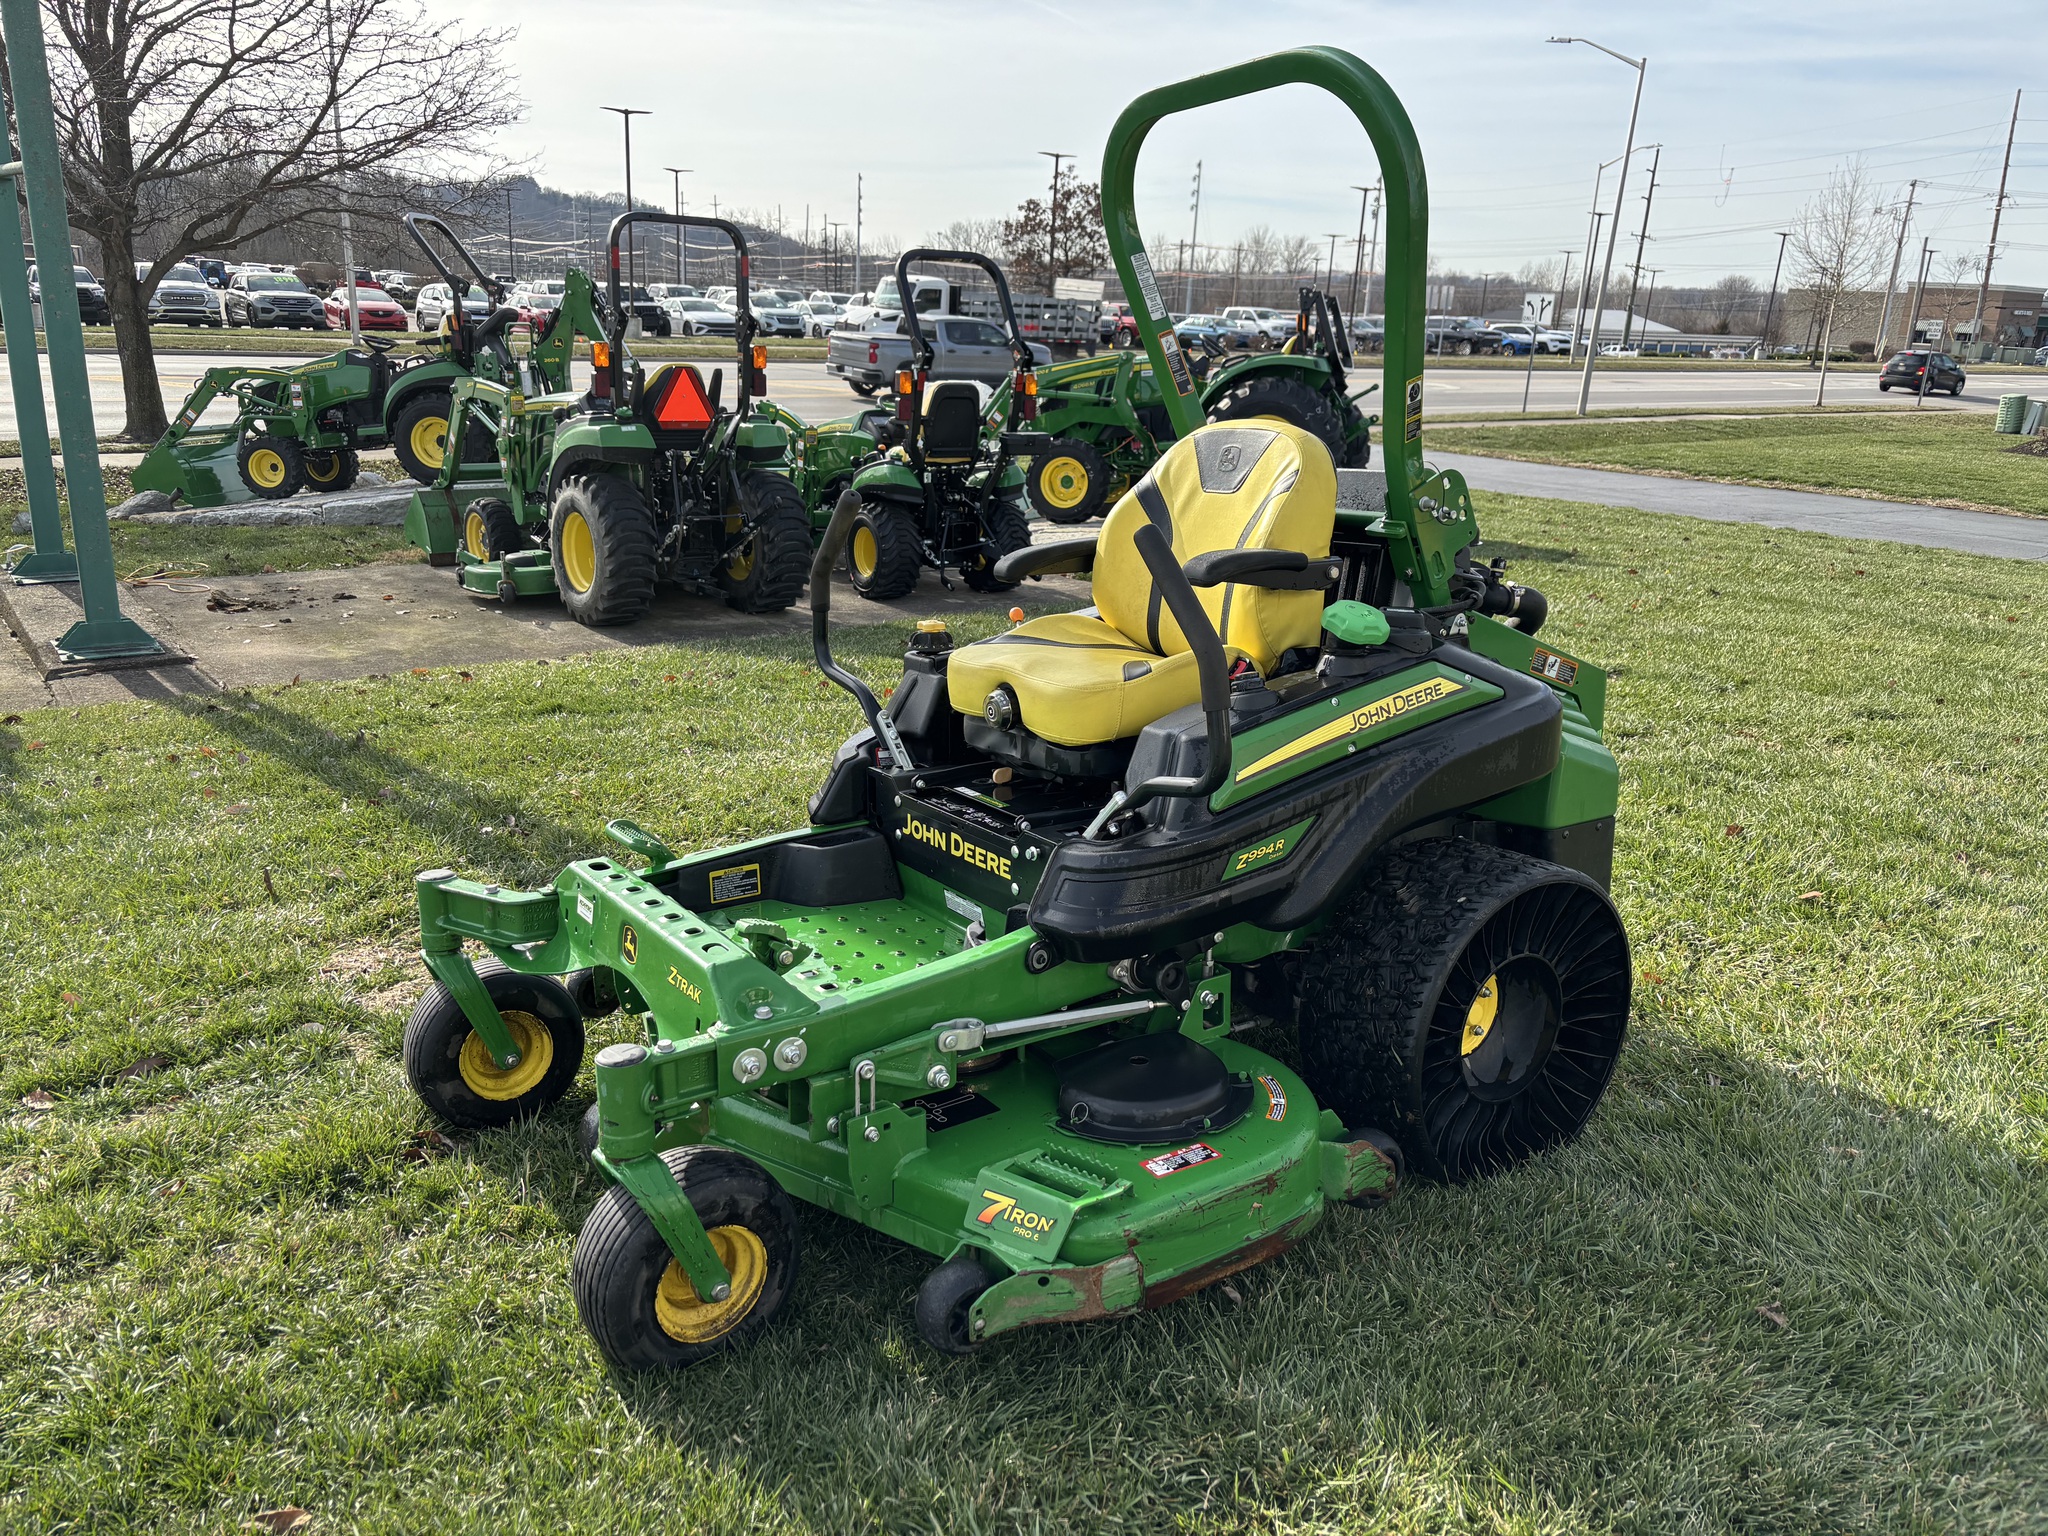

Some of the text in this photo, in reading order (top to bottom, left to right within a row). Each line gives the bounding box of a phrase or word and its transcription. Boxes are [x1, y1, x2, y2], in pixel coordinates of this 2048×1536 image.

[1350, 683, 1443, 732] JOHN DEERE
[902, 813, 947, 852] JOHN
[950, 831, 1012, 880] DEERE
[667, 965, 702, 1004] ZTRAK
[1012, 1226, 1032, 1239] PRO
